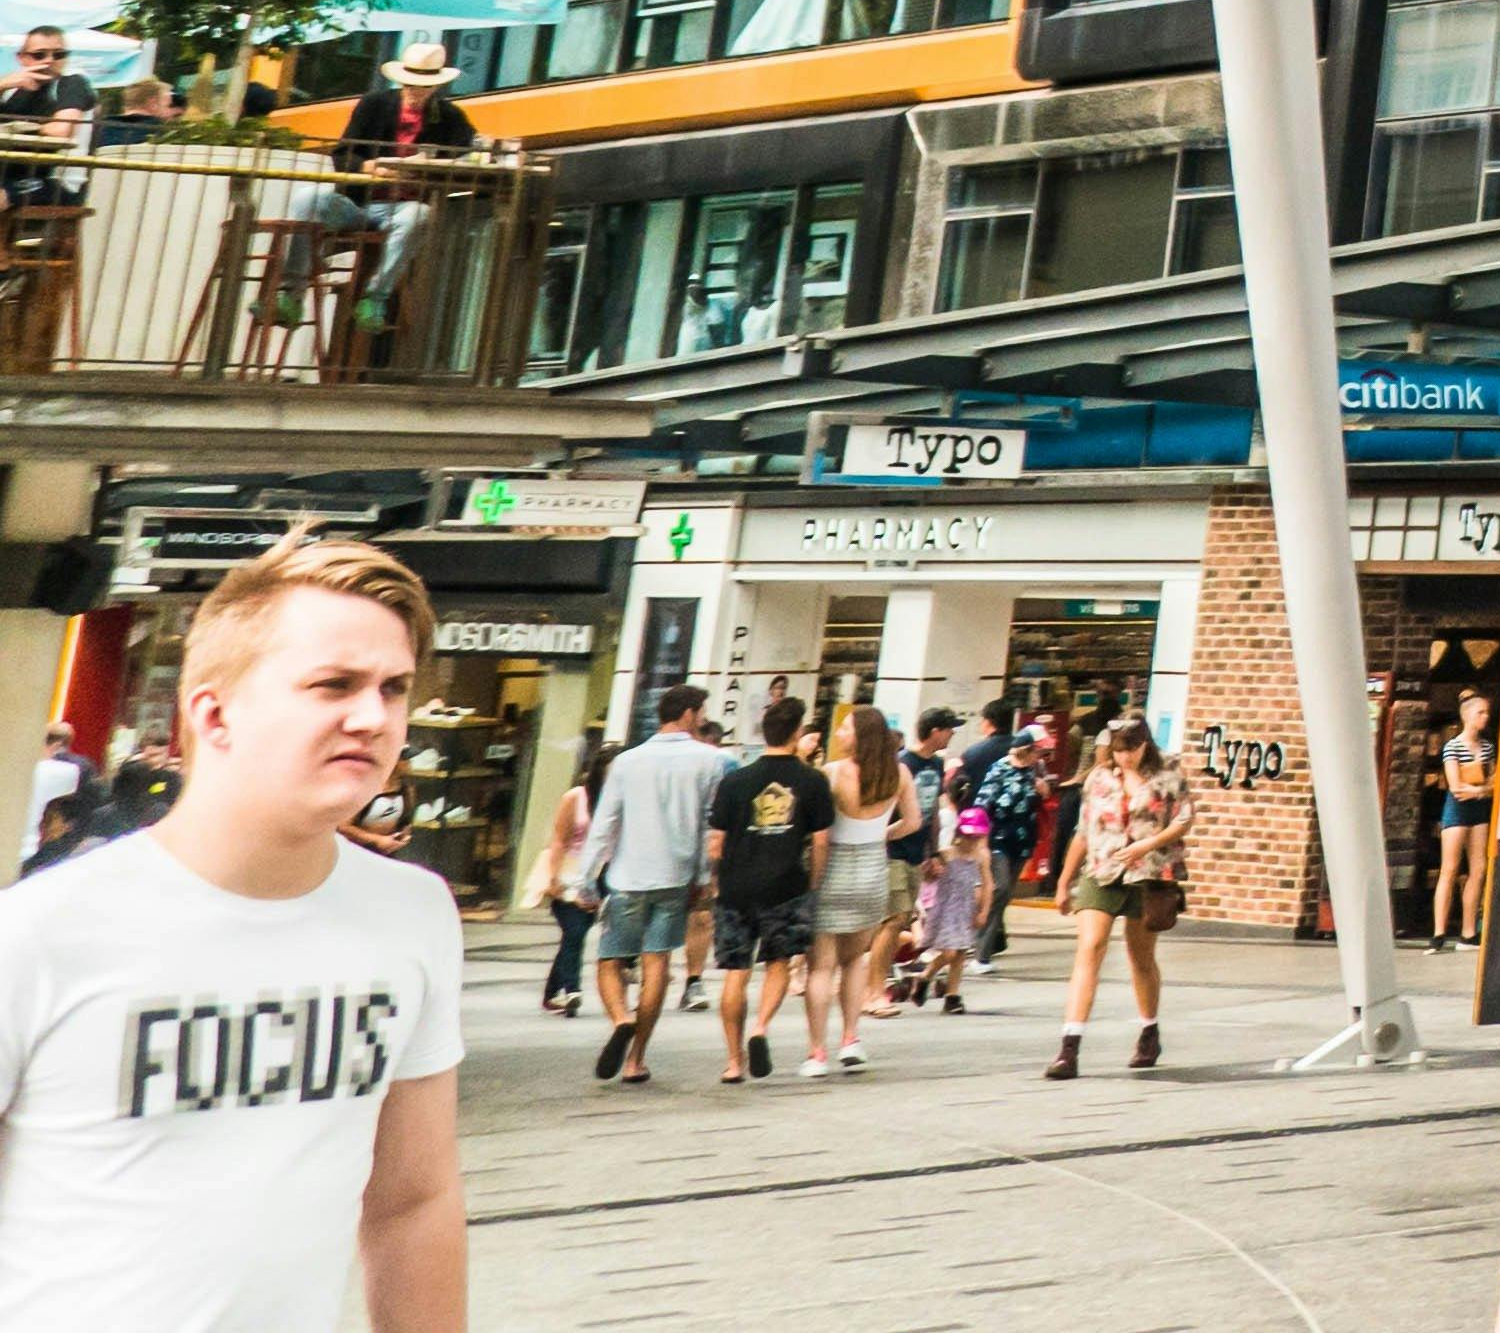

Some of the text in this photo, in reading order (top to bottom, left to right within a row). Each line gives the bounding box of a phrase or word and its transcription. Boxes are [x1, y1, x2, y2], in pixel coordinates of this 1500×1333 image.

[1340, 376, 1485, 410] citibank
[886, 426, 1003, 475] Typo
[523, 495, 634, 511] PHARMACY
[801, 516, 994, 552] PHARMACY
[1202, 724, 1287, 790] Typo
[122, 986, 398, 1118] FOCUS
